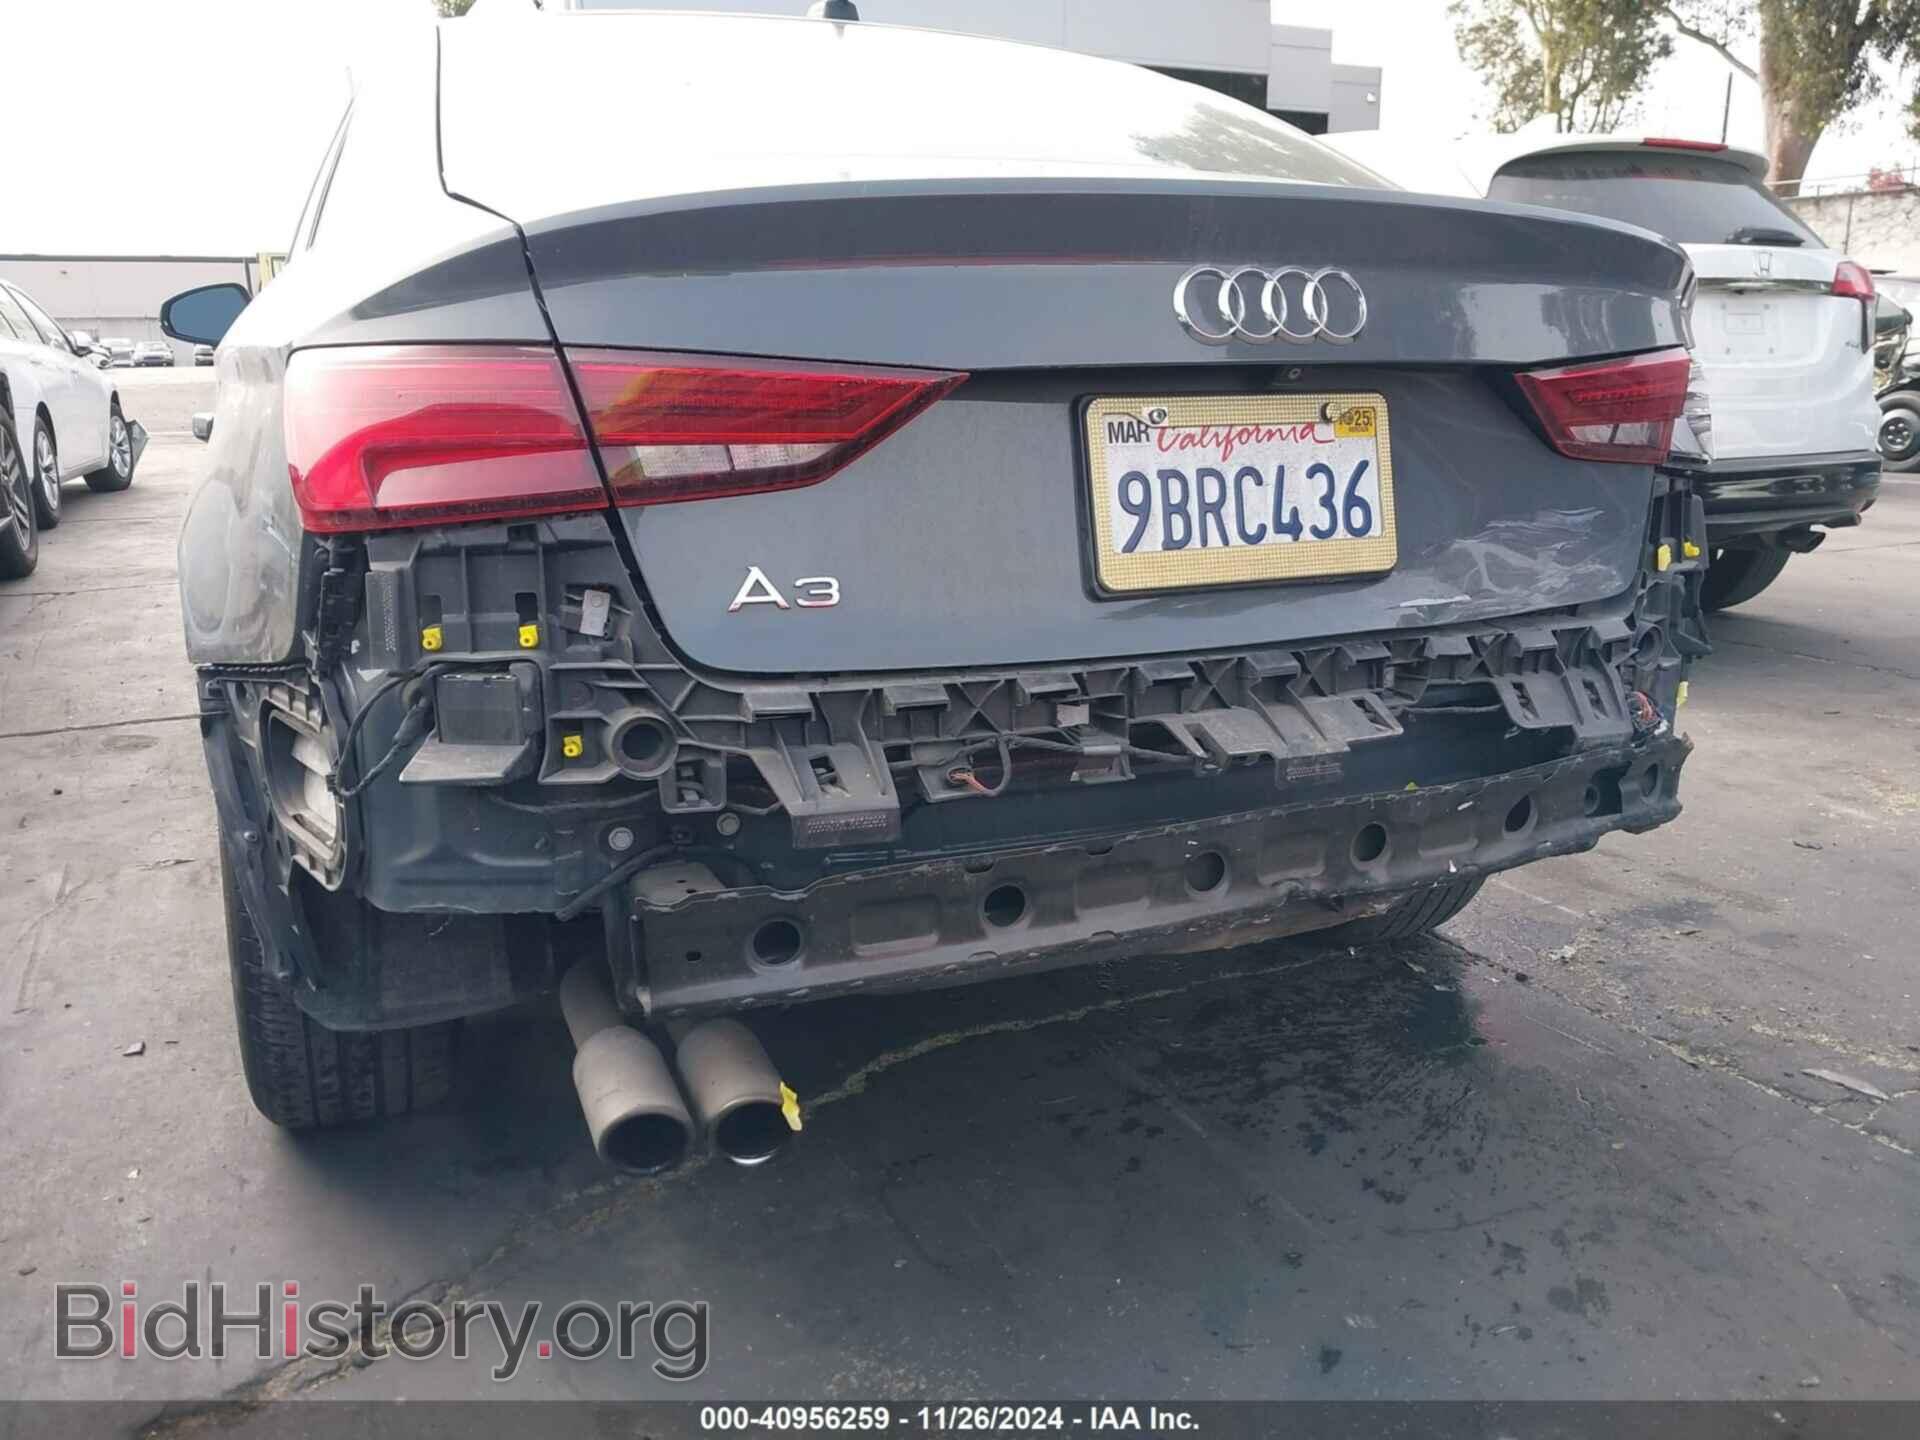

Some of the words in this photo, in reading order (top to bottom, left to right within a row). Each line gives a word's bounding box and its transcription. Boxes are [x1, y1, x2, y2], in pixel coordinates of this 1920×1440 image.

[1354, 409, 1370, 426] 25
[1107, 420, 1150, 443] MAR
[1156, 421, 1335, 462] California
[1117, 459, 1373, 554] 9BRC436
[727, 565, 841, 612] A3
